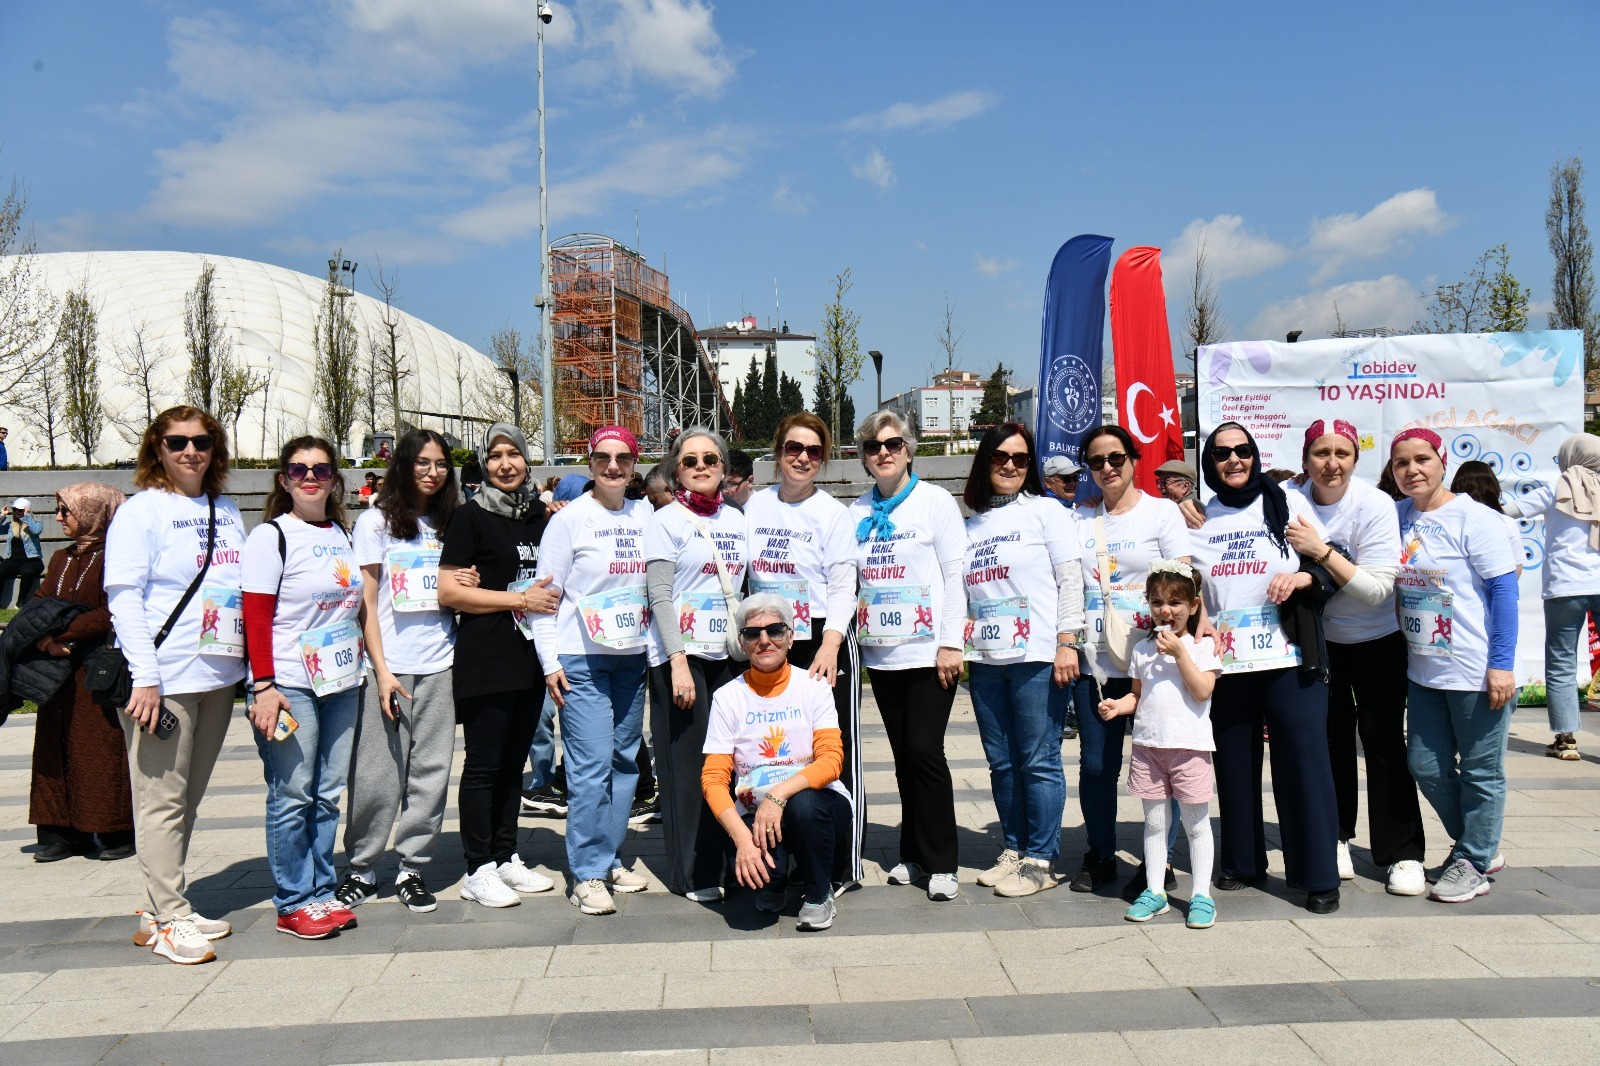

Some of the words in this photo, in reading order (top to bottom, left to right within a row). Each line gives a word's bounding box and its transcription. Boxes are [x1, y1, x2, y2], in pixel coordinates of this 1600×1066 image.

[1221, 394, 1243, 402] Fırsat
[1245, 393, 1272, 403] Eşitliği
[1318, 385, 1341, 401] 10
[1346, 383, 1446, 404] YAŞINDA!
[1221, 403, 1238, 411] Özel
[1240, 404, 1265, 412] Eğitim
[1254, 413, 1287, 421] Hoşgörü
[1464, 408, 1540, 445] AĞACI
[1254, 432, 1283, 440] Desteği
[1049, 441, 1080, 455] BALIKES
[615, 537, 636, 548] VARIZ
[766, 537, 790, 550] VARIZ
[871, 542, 896, 554] VARIZ
[1228, 538, 1255, 550] VARIZ
[196, 548, 240, 568] GÜLÜYÜZ
[759, 547, 790, 560] BİRLİKTE
[974, 544, 998, 558] VARIZ
[1221, 549, 1257, 561] BİRLİKTE
[609, 559, 647, 575] GÜÇLÜYÜ
[751, 557, 796, 574] GÜÇLÜYÜZ
[866, 553, 896, 566] BİRLİKTE
[970, 555, 999, 571] BİRLİKTE
[861, 564, 906, 581] GÜÇLÜYÜZ
[965, 564, 1010, 586] GÜÇLÜYÜZ
[1211, 559, 1268, 577] GÜÇLÜYÜZ
[422, 575, 438, 590] 02
[233, 617, 243, 635] 15
[615, 612, 636, 629] 056
[709, 617, 728, 633] 092
[880, 611, 902, 627] 048
[1404, 615, 1421, 633] 026
[981, 624, 1001, 640] 032
[1250, 632, 1273, 650] 132
[334, 647, 354, 668] 036
[745, 706, 802, 725] Otizm'in
[769, 758, 794, 766] Olmak
